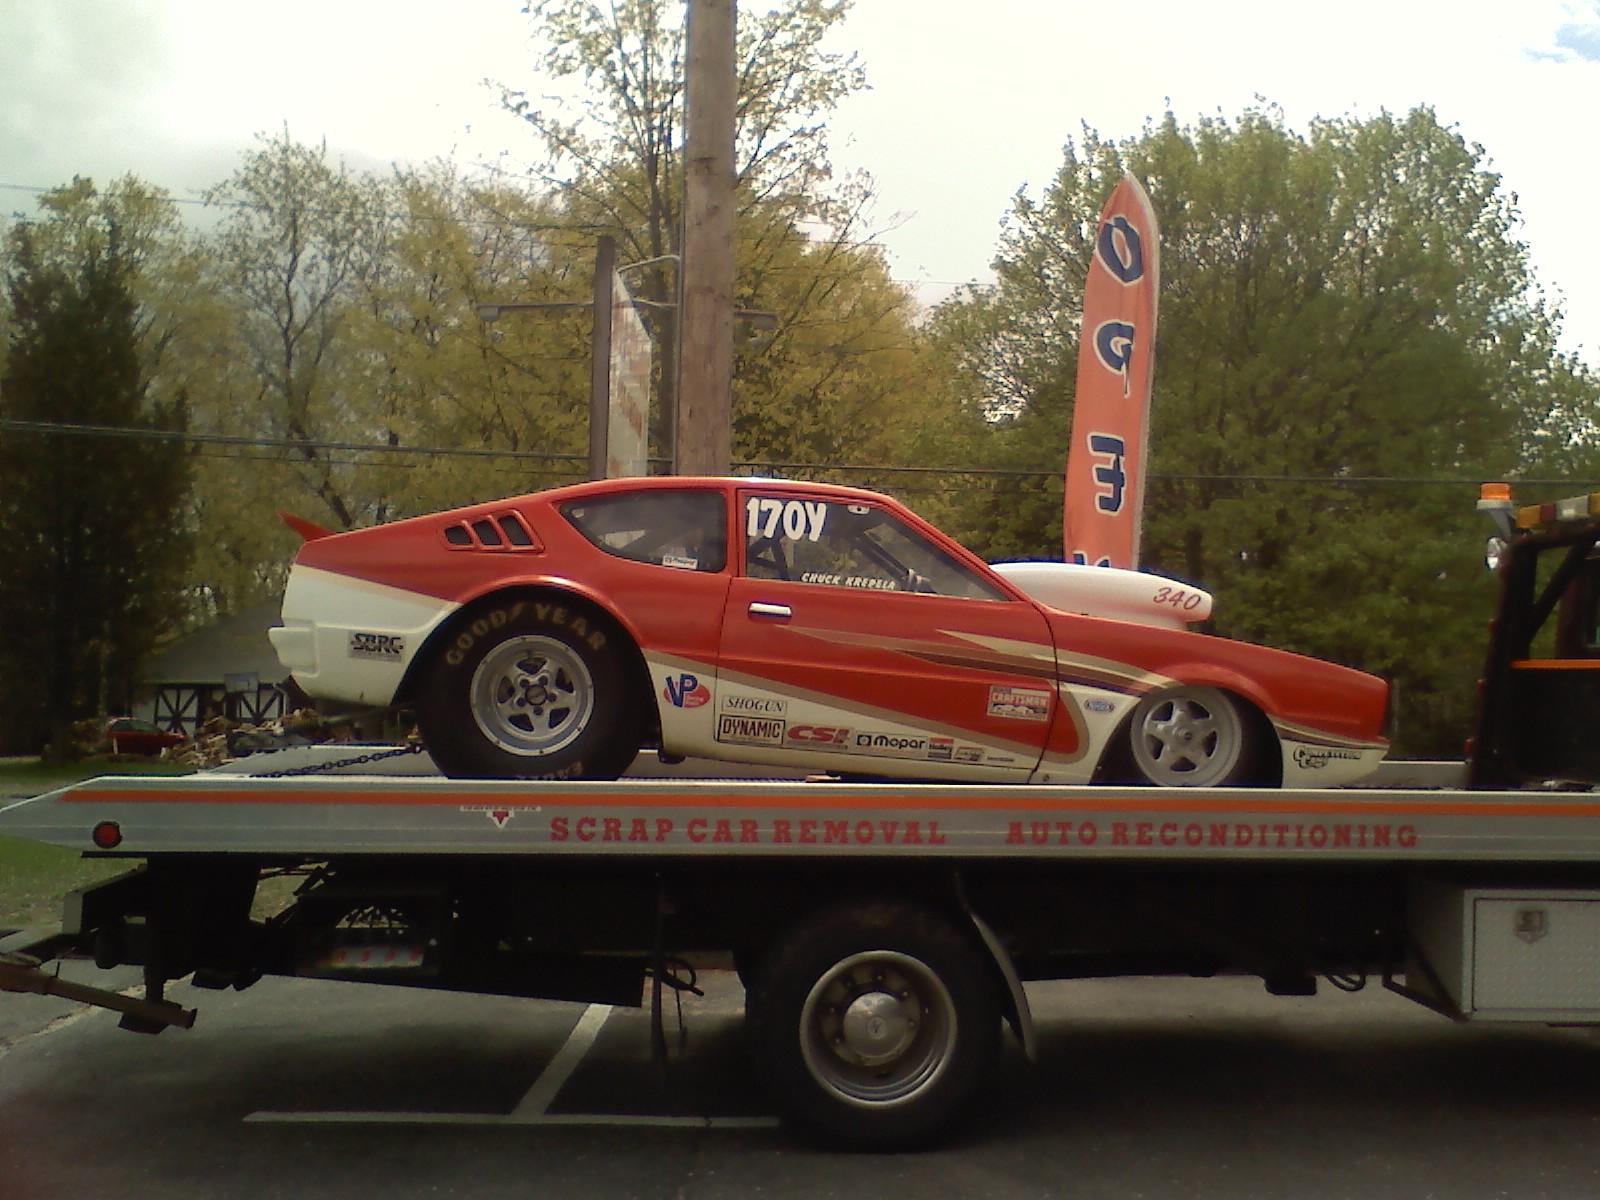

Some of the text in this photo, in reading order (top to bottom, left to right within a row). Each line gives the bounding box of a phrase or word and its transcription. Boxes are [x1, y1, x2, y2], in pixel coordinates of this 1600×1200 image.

[747, 497, 827, 542] 170Y
[801, 572, 841, 585] CHUCK
[1153, 587, 1201, 609] 340
[665, 673, 698, 708] VP
[727, 697, 784, 712] SHOGUN
[722, 719, 780, 738] DYNAMIC
[549, 816, 1418, 848] SCRAP CAR REMOVAL AUTO RECONDITIONING
